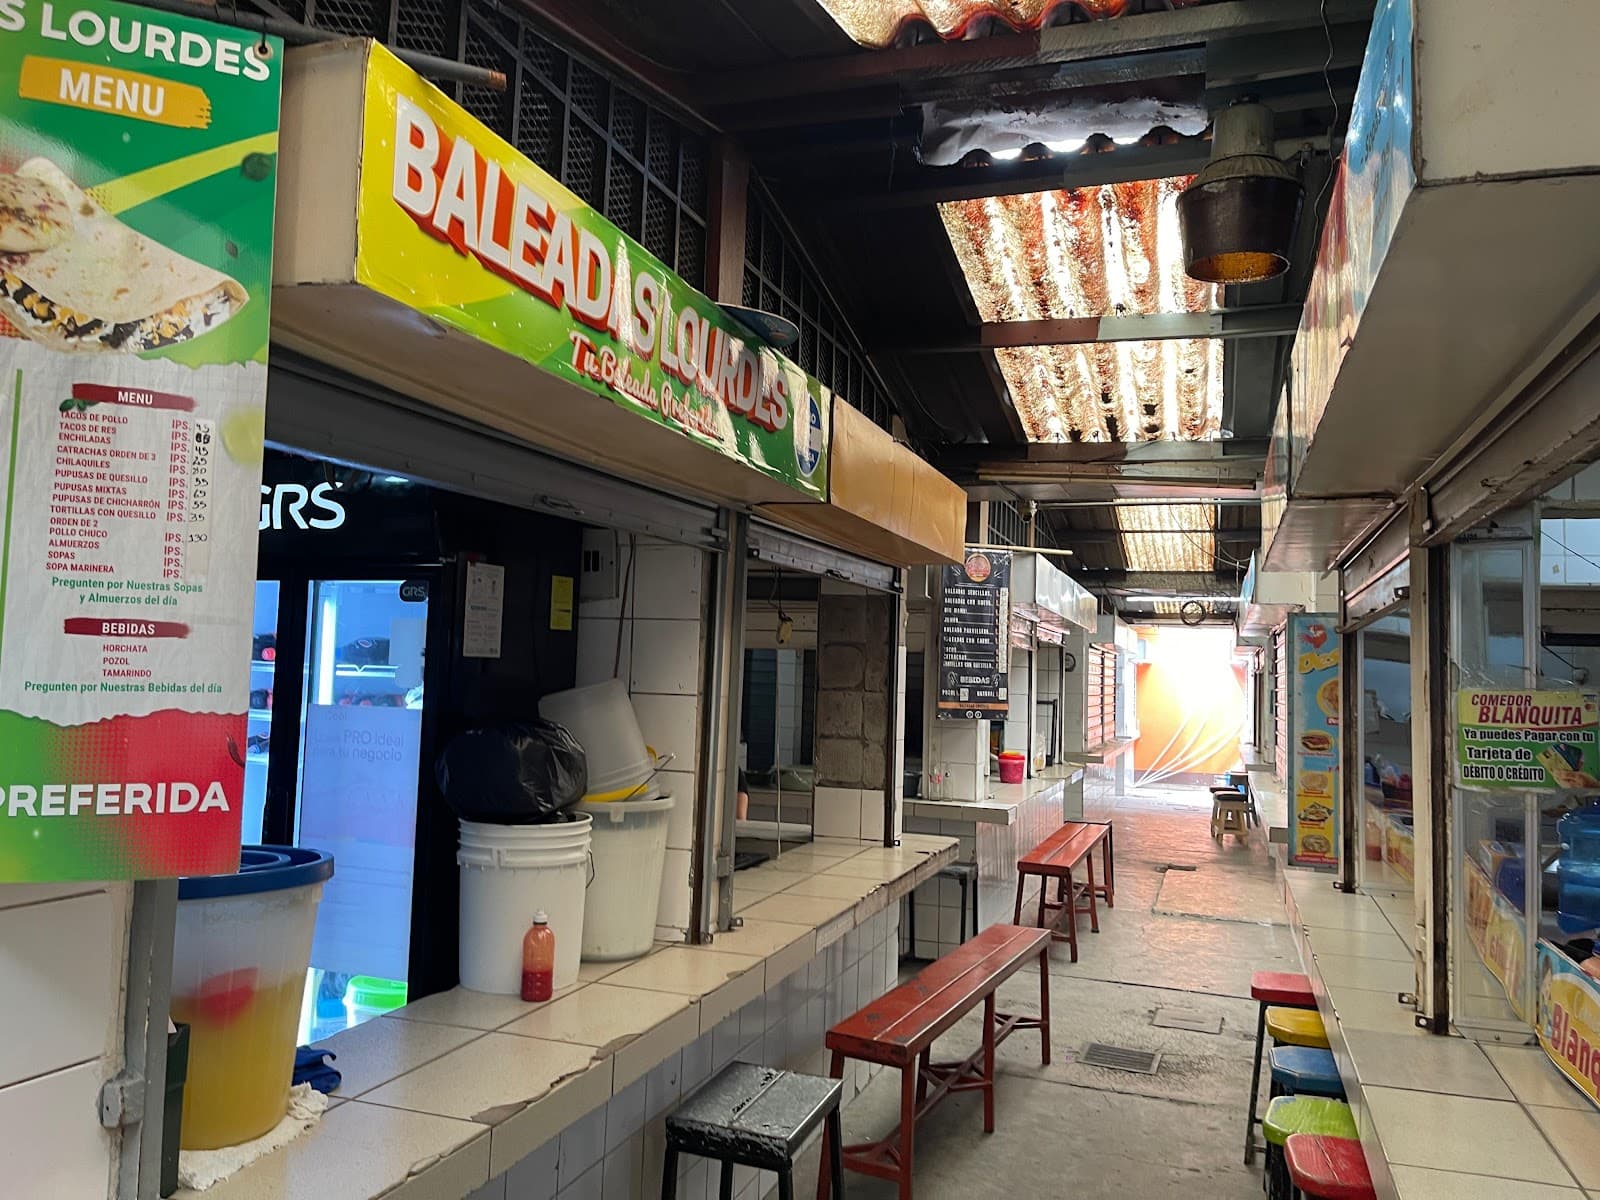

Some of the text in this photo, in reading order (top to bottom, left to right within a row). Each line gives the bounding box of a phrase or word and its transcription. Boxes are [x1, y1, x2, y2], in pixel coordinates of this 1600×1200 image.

[41, 3, 270, 81] LOURDES
[59, 68, 165, 117] MENU
[118, 392, 153, 405] MENU
[60, 410, 87, 420] TACOS
[102, 415, 128, 424] POLLO
[60, 422, 86, 432] TACOS
[102, 426, 116, 434] RES
[59, 432, 111, 444] ENCHILADAS
[57, 446, 107, 456] CATRACHAS
[110, 450, 136, 458] ORDEN
[56, 457, 110, 468] CHILAQUILES
[55, 469, 94, 480] PUPUSAS
[109, 474, 148, 484] QUESILLO
[54, 482, 93, 492] PUPUSAS
[96, 486, 126, 494] MIXTAS
[52, 494, 92, 504] PUPUSAS
[50, 506, 95, 515] TORTILLAS
[98, 508, 115, 516] CON
[118, 510, 156, 520] QUESILLO
[50, 517, 98, 528] ORDEN DE 2
[50, 528, 76, 536] POLLO
[78, 529, 108, 538] CHUCO
[49, 540, 100, 549] ALMUERZOS
[48, 551, 75, 560] SOPAS
[46, 562, 68, 571] SOPA
[70, 564, 114, 573] MARINERA
[52, 576, 203, 594] Pregunten por Nuestras Sopas
[79, 592, 178, 606] y Almuerzos del día
[102, 622, 156, 636] BEBIDAS
[102, 644, 148, 654] HORCHATA
[102, 656, 130, 666] POZOL
[102, 668, 152, 678] TAMARINDO
[960, 676, 990, 684] BEBIDAS
[24, 681, 222, 694] Pregunten por Nuestras Bebidas del día
[1471, 694, 1532, 706] COMEDOR
[1478, 705, 1582, 725] BLANQUITA
[1464, 728, 1594, 742] Ya puedes Pagar con tu
[1466, 746, 1531, 760] Tarjeta de
[1464, 763, 1544, 780] DÉBITO O CRÉDITO
[0, 782, 230, 816] REFERIDA
